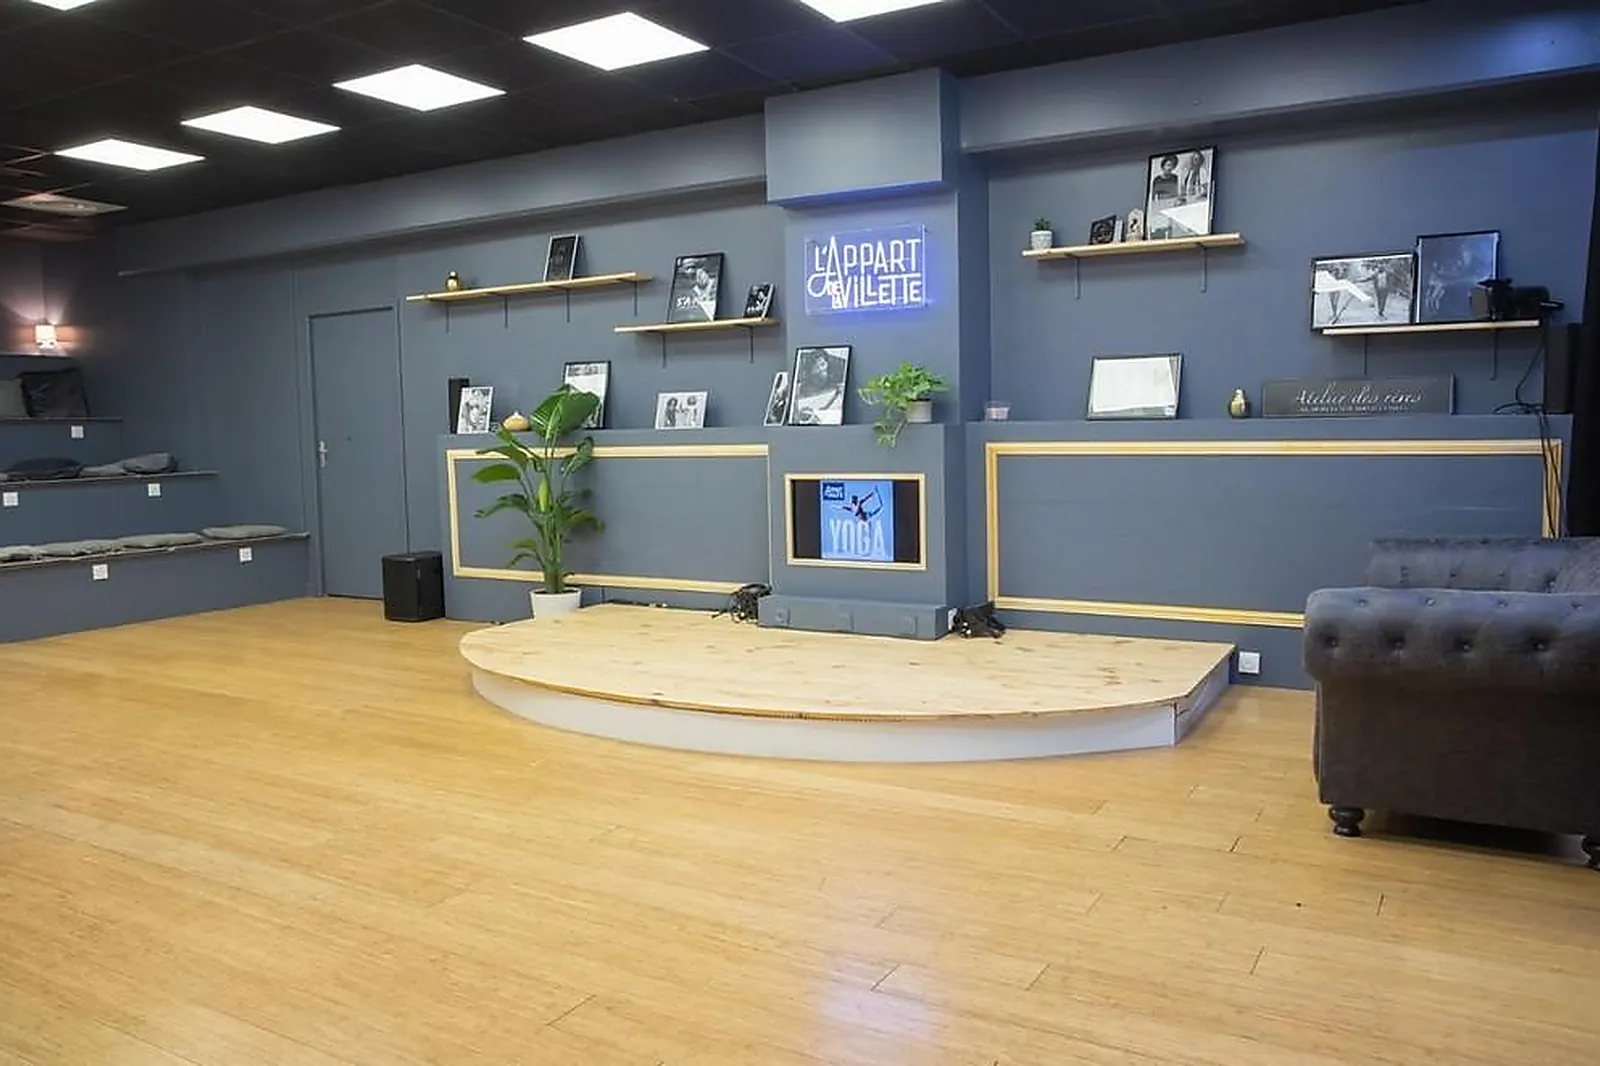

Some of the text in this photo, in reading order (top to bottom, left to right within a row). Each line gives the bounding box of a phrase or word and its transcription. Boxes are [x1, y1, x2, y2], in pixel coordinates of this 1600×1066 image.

[809, 236, 921, 281] L'APPART
[841, 273, 922, 308] VILLETTE
[1296, 381, 1346, 405] Atelier
[1351, 383, 1380, 404] des
[829, 518, 885, 556] YOGA
